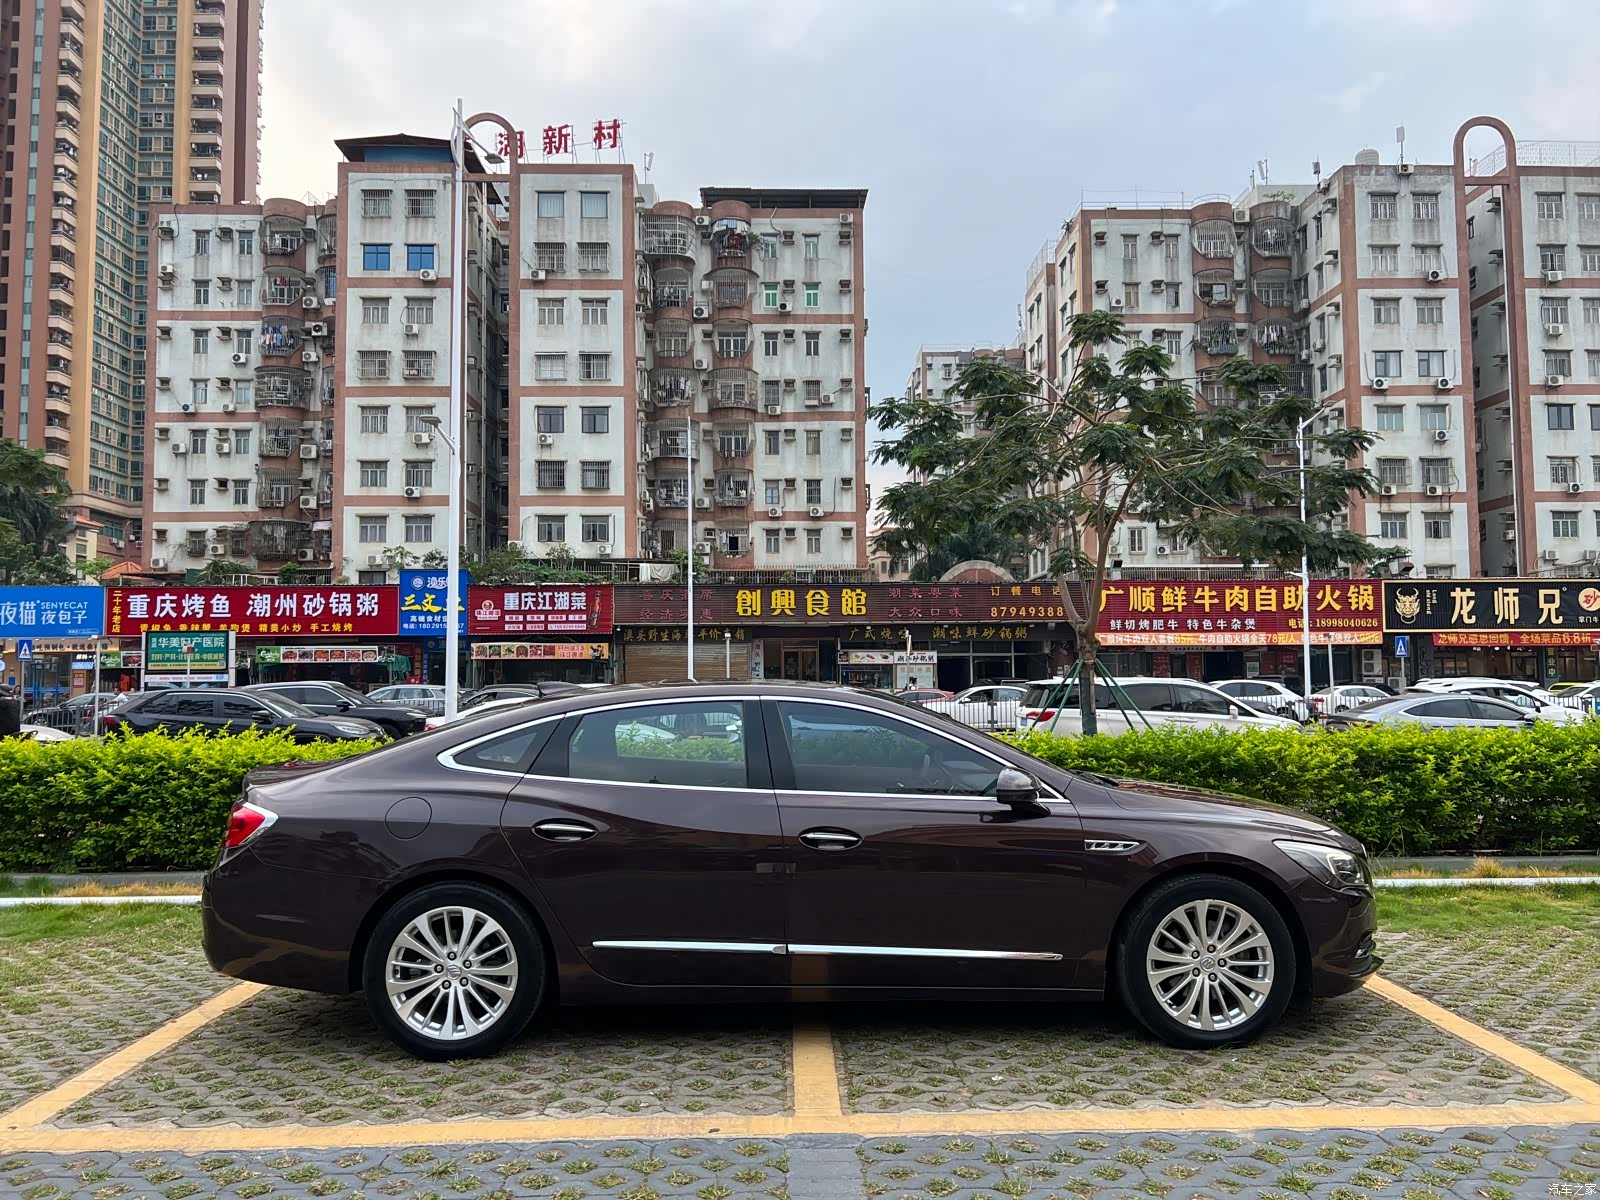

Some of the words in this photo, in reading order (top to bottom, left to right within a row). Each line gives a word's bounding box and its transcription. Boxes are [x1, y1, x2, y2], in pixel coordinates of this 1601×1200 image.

[991, 586, 1062, 597] 订餐电话
[1099, 584, 1374, 612] 广顺鲜牛肉自助火锅
[127, 593, 232, 618] 重庆烤鱼
[246, 592, 379, 617] 潮州砂锅粥
[504, 592, 587, 611] 重庆江湖菜
[735, 588, 867, 616] 創興食館
[1450, 587, 1563, 625] 龙师兄
[0, 602, 37, 625] 夜猫
[41, 610, 88, 625] 夜包子
[112, 590, 122, 633] 二十年老店
[888, 607, 962, 617] 大众口味
[991, 606, 1064, 617] 87949388
[1110, 619, 1179, 631] 鲜切烤肥牛
[1187, 618, 1256, 631] 特色牛杂煲
[1316, 618, 1378, 627] 18998040626
